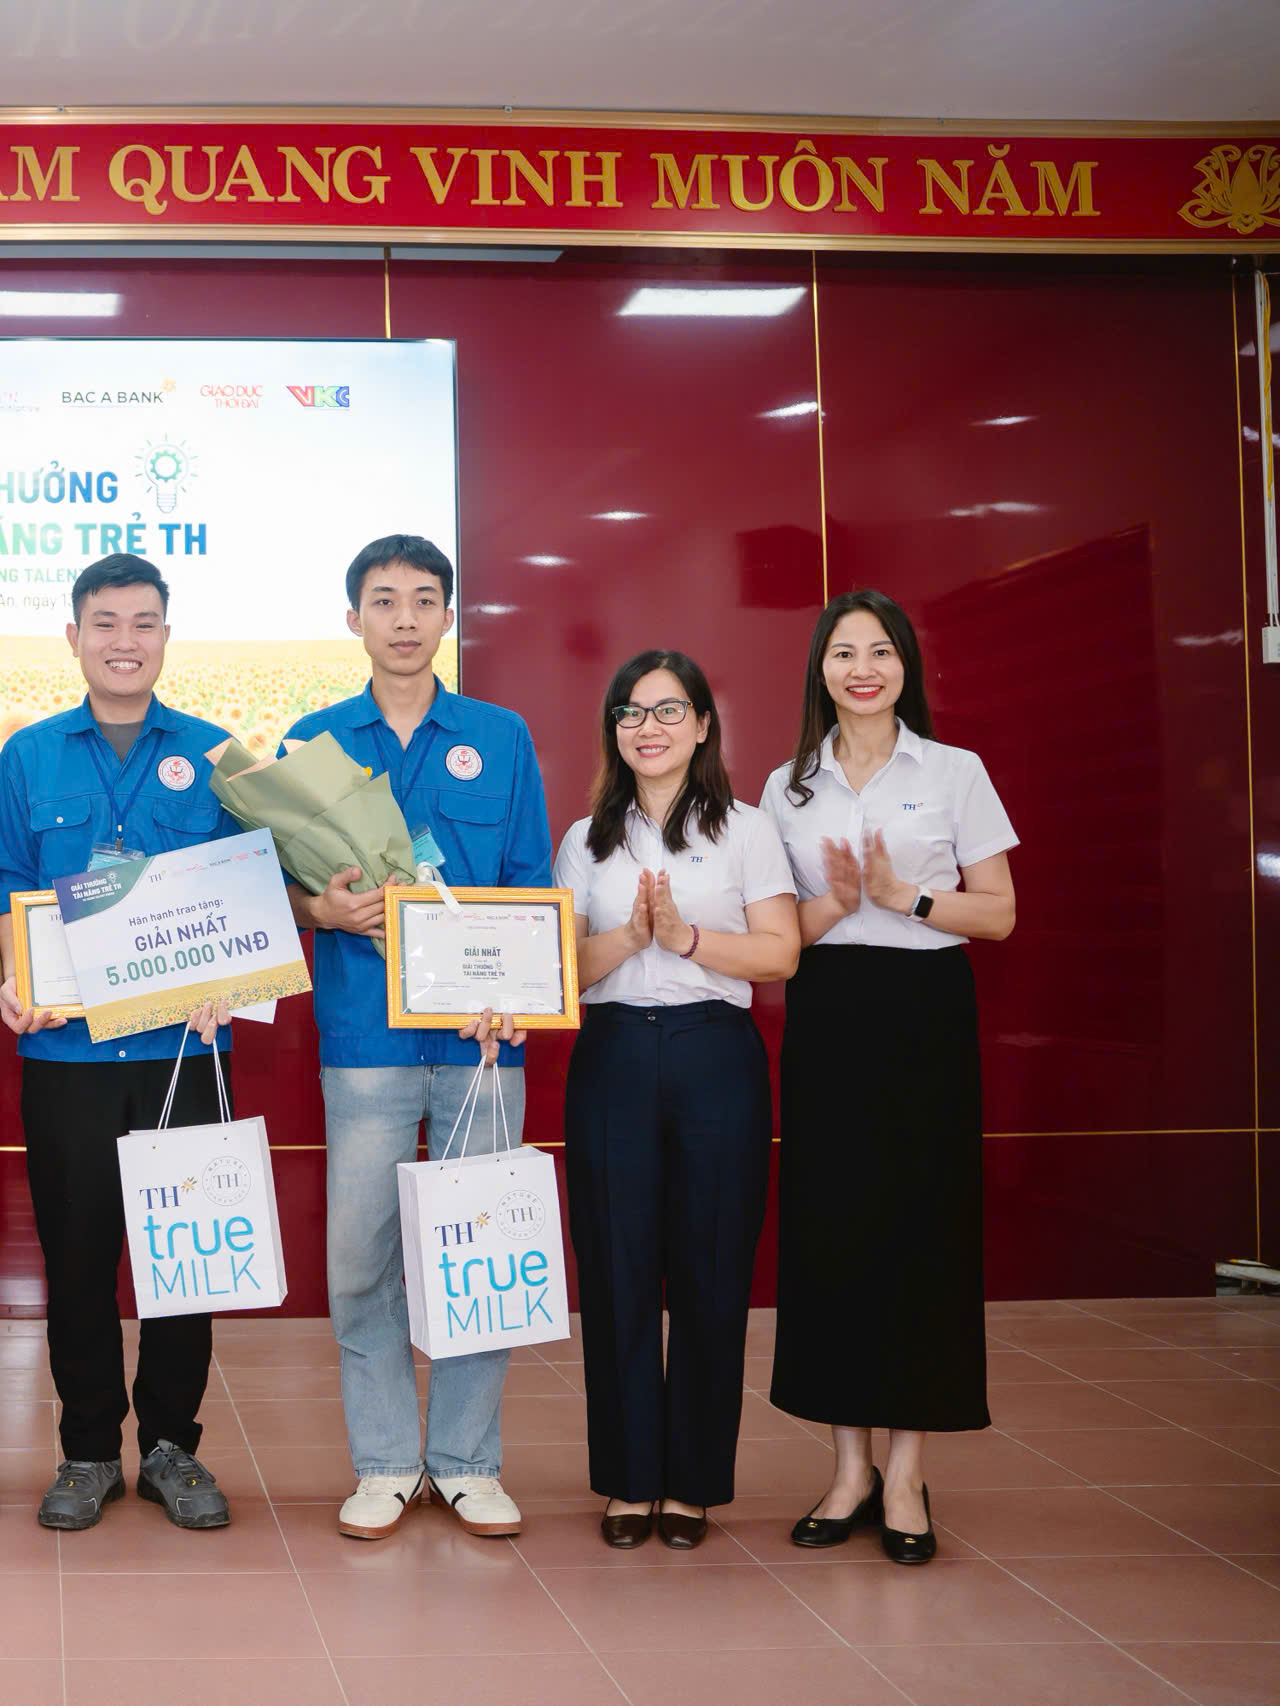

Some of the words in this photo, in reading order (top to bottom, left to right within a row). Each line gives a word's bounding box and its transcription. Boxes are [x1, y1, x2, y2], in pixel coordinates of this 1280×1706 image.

[108, 144, 391, 215] QUANG
[409, 147, 623, 208] VINH
[650, 140, 889, 212] MUÔN
[916, 143, 1101, 217] NĂM
[100, 391, 113, 404] A
[117, 391, 164, 404] BANK
[285, 385, 351, 408] VKC
[74, 512, 147, 556] TRẺ
[158, 523, 207, 555] TH
[128, 916, 148, 926] Hân
[150, 909, 175, 922] hạnh
[176, 905, 197, 915] trao
[134, 925, 172, 952] GIẢI
[176, 912, 228, 942] NHẤT
[106, 943, 216, 986] 5.000.000
[219, 930, 270, 958] VNĐ
[464, 946, 480, 957] GIẢI
[139, 1185, 182, 1210] TH
[212, 1173, 239, 1189] TH
[507, 1206, 534, 1223] TH
[143, 1214, 254, 1261] true
[434, 1221, 476, 1247] TH
[151, 1253, 262, 1301] MILK
[438, 1249, 549, 1299] true
[446, 1286, 554, 1339] MILK
